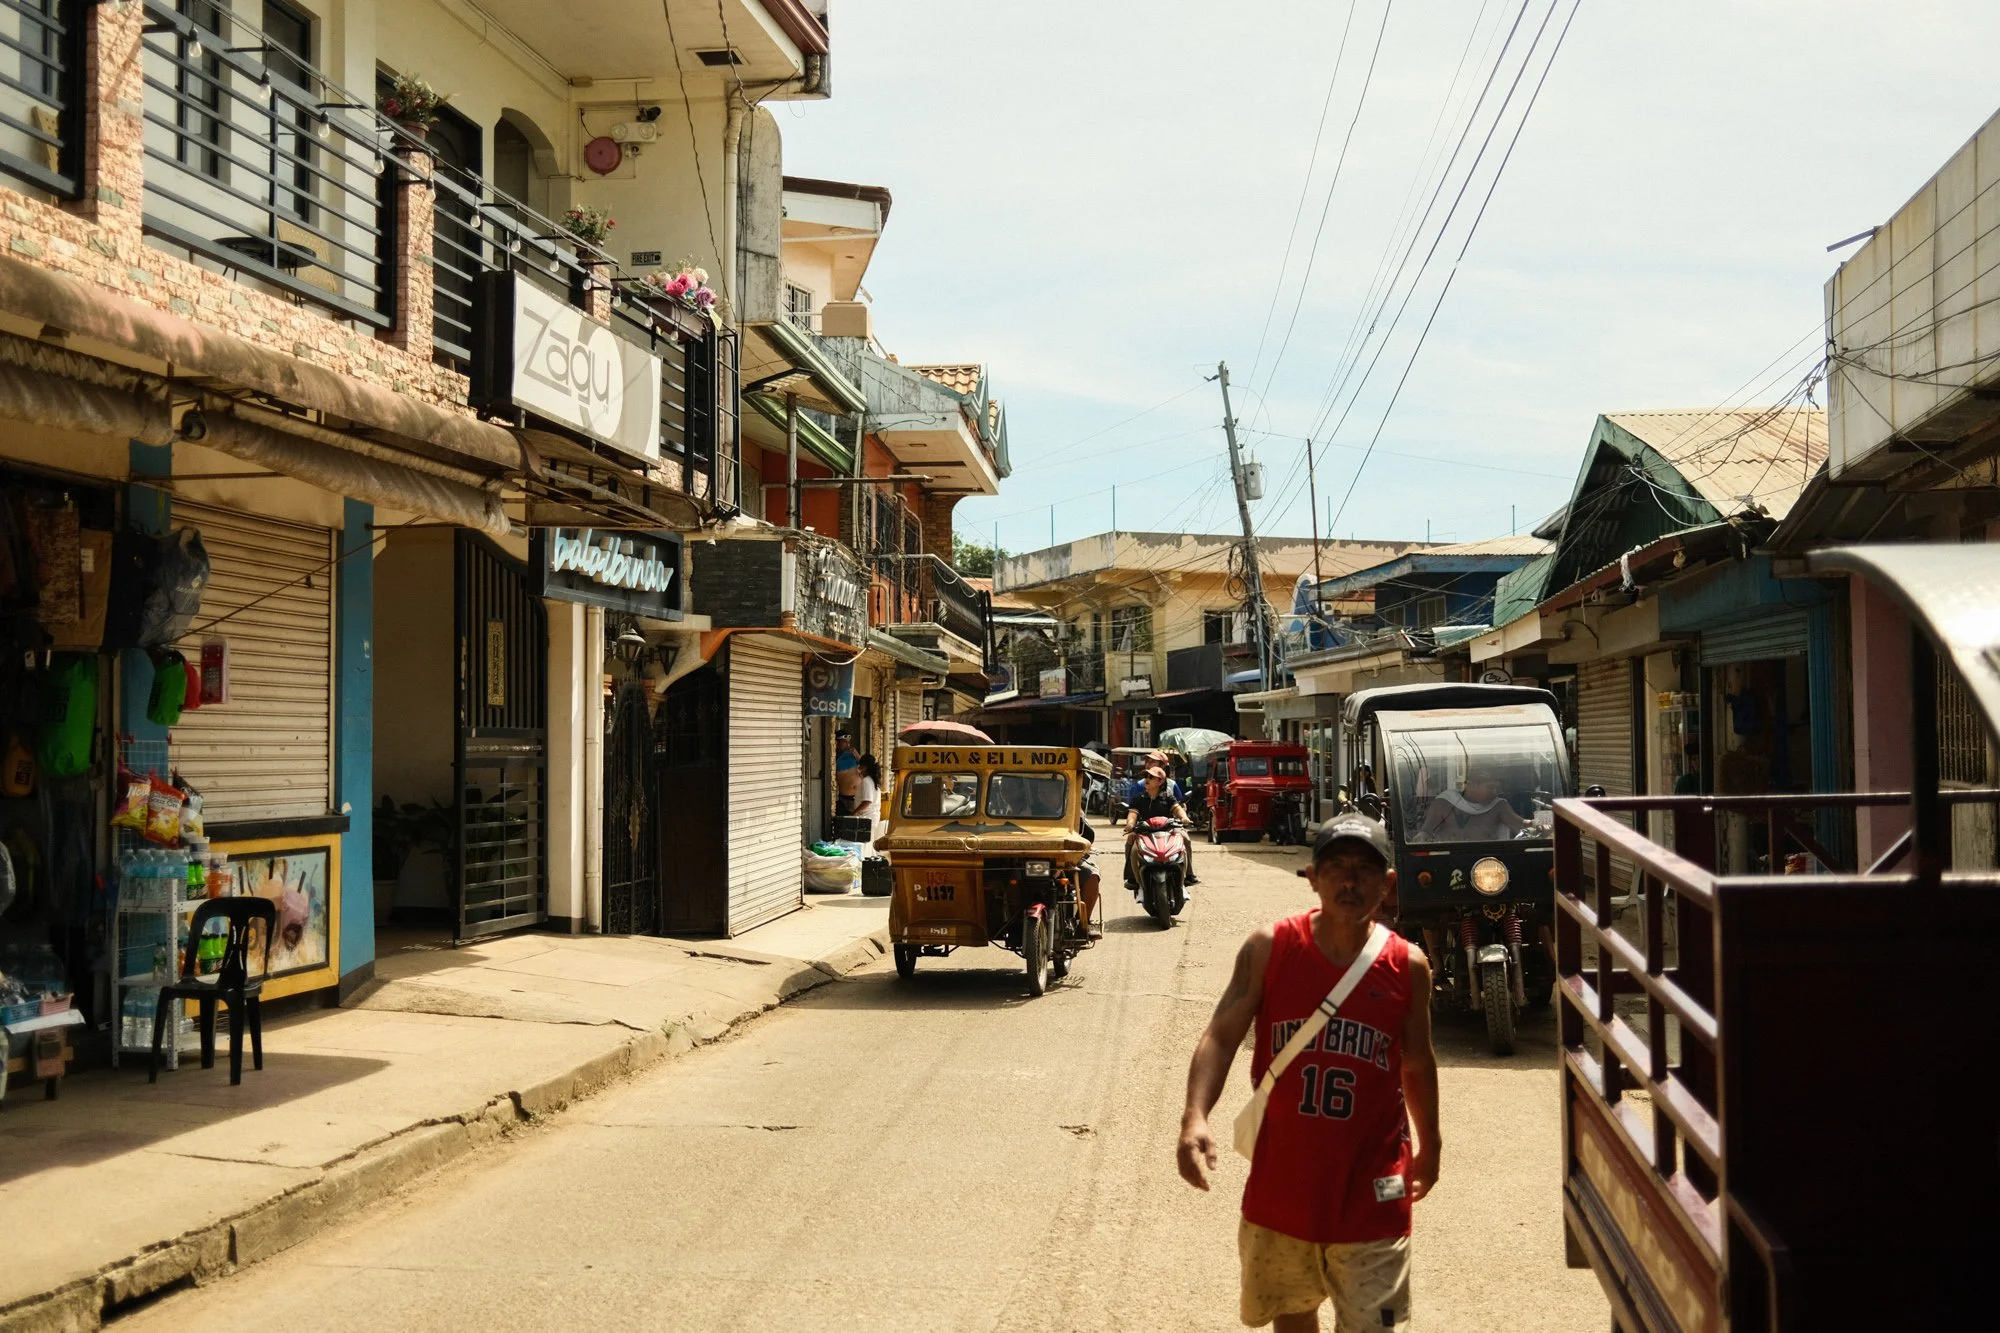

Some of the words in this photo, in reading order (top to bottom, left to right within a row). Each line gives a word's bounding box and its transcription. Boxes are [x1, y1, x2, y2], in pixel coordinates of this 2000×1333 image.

[632, 253, 644, 265] FIRE
[644, 252, 655, 264] EXIT
[523, 307, 610, 415] Zagu
[810, 696, 847, 713] Cash
[1271, 1018, 1319, 1058] UN
[1298, 1064, 1357, 1121] 16
